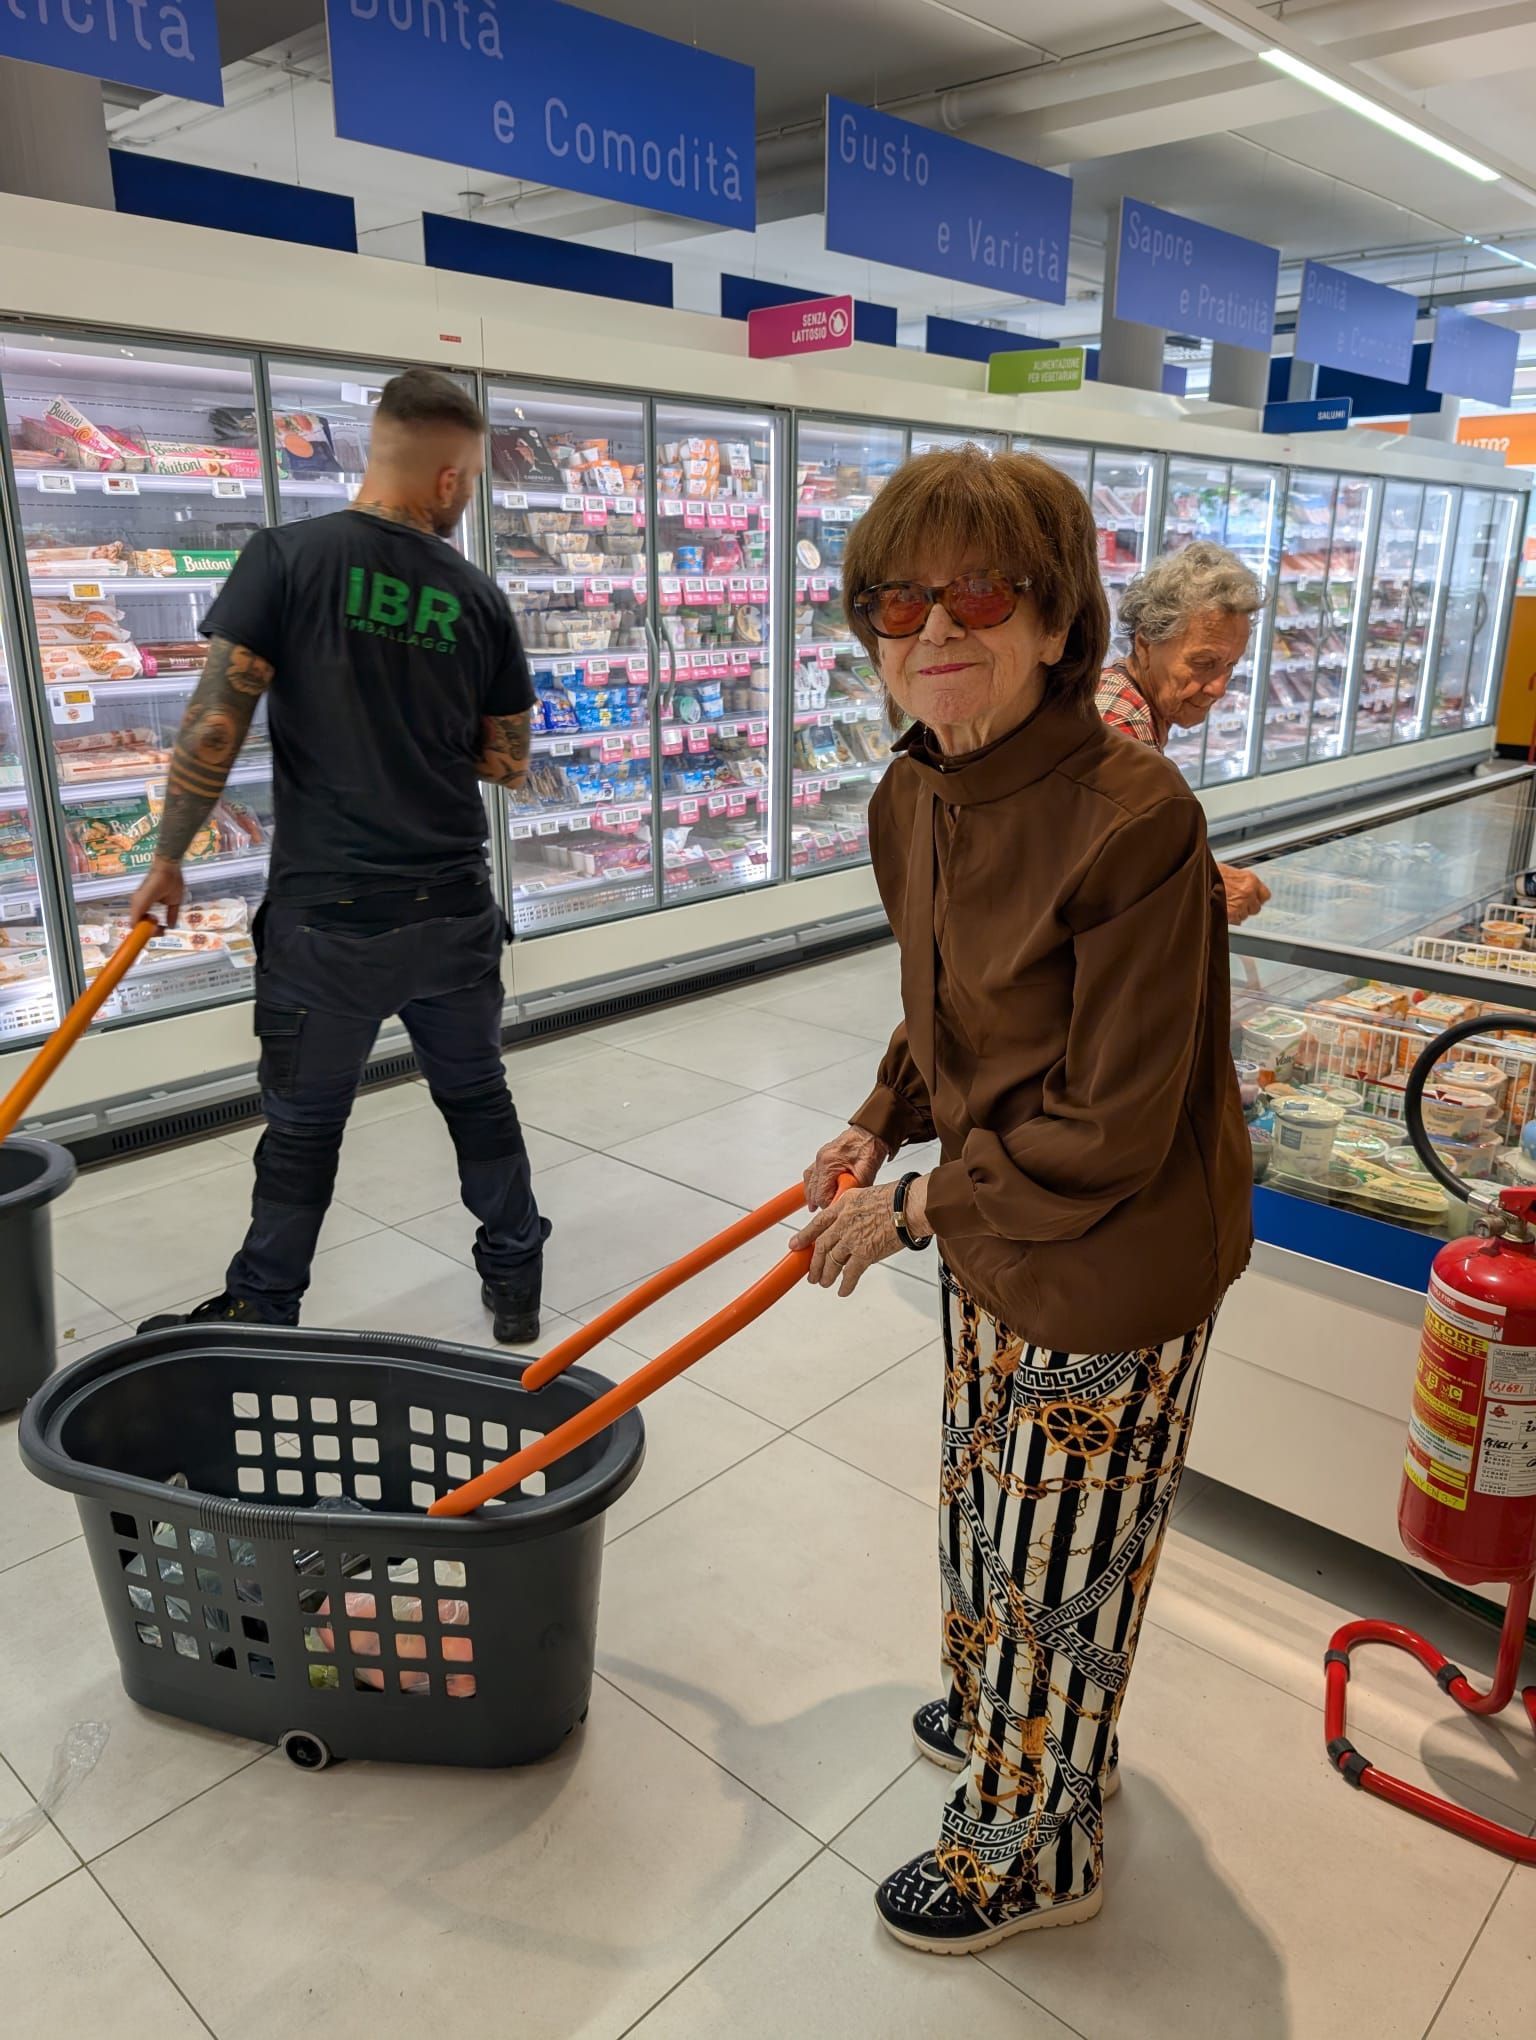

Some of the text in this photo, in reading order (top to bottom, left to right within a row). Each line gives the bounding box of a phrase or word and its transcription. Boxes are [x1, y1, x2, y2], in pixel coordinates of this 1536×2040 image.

[493, 97, 743, 202] e Comodità
[839, 113, 930, 187] Gusto
[937, 216, 1061, 284] e Varietà
[1127, 210, 1194, 268] Sapore
[1179, 283, 1270, 336] e Praticità
[1305, 269, 1348, 313] Bontà
[791, 326, 828, 344] LATTOSIO
[802, 311, 827, 328] SENZA
[48, 400, 84, 428] Buitoni
[1317, 410, 1346, 421] SALUMI
[157, 458, 203, 476] Buitoni
[183, 555, 232, 573] Buitoni
[345, 566, 462, 642] IBR
